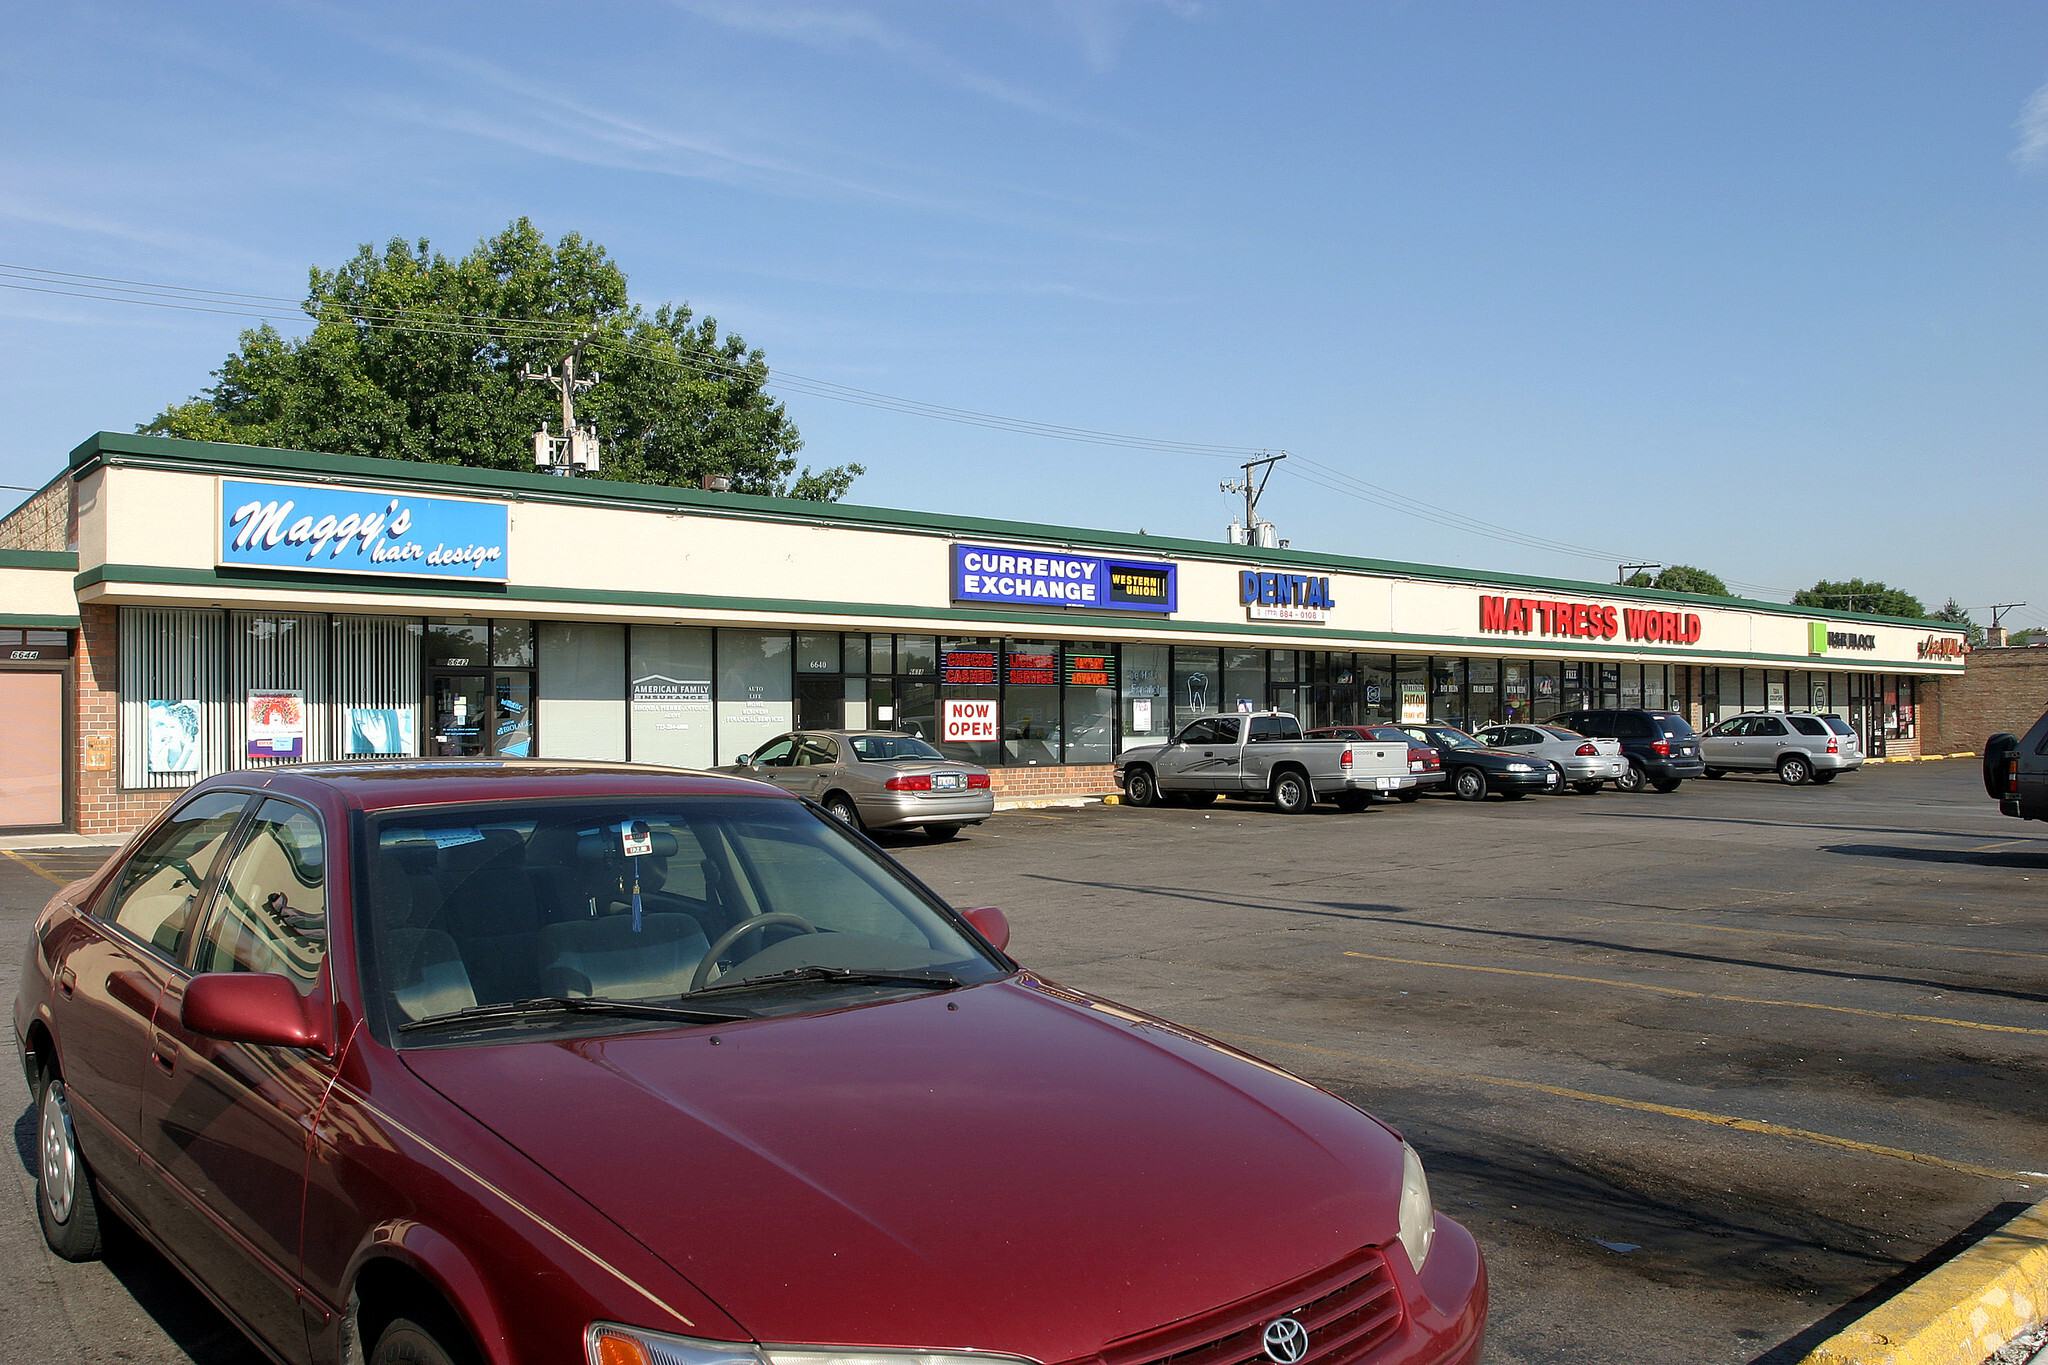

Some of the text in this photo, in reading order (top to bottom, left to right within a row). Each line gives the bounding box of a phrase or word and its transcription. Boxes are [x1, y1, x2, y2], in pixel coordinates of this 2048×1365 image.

[230, 499, 412, 561] Maggy's
[371, 538, 502, 571] hair design
[964, 553, 1096, 580] CURRENCY
[1112, 574, 1157, 587] WESTERN
[964, 575, 1096, 601] EXCHANGE
[1126, 586, 1157, 597] UNION
[1239, 571, 1335, 609] DENTAL
[1279, 610, 1293, 618] 884
[1300, 611, 1317, 619] 0108
[1479, 595, 1701, 645] MATTRESS WORLD
[11, 651, 38, 659] 6644
[946, 653, 994, 667] CHECKS
[810, 661, 827, 669] 6640
[946, 670, 993, 683] CASHED
[1405, 694, 1425, 707] FUTON
[953, 704, 989, 718] NOW
[949, 722, 992, 736] OPEN
